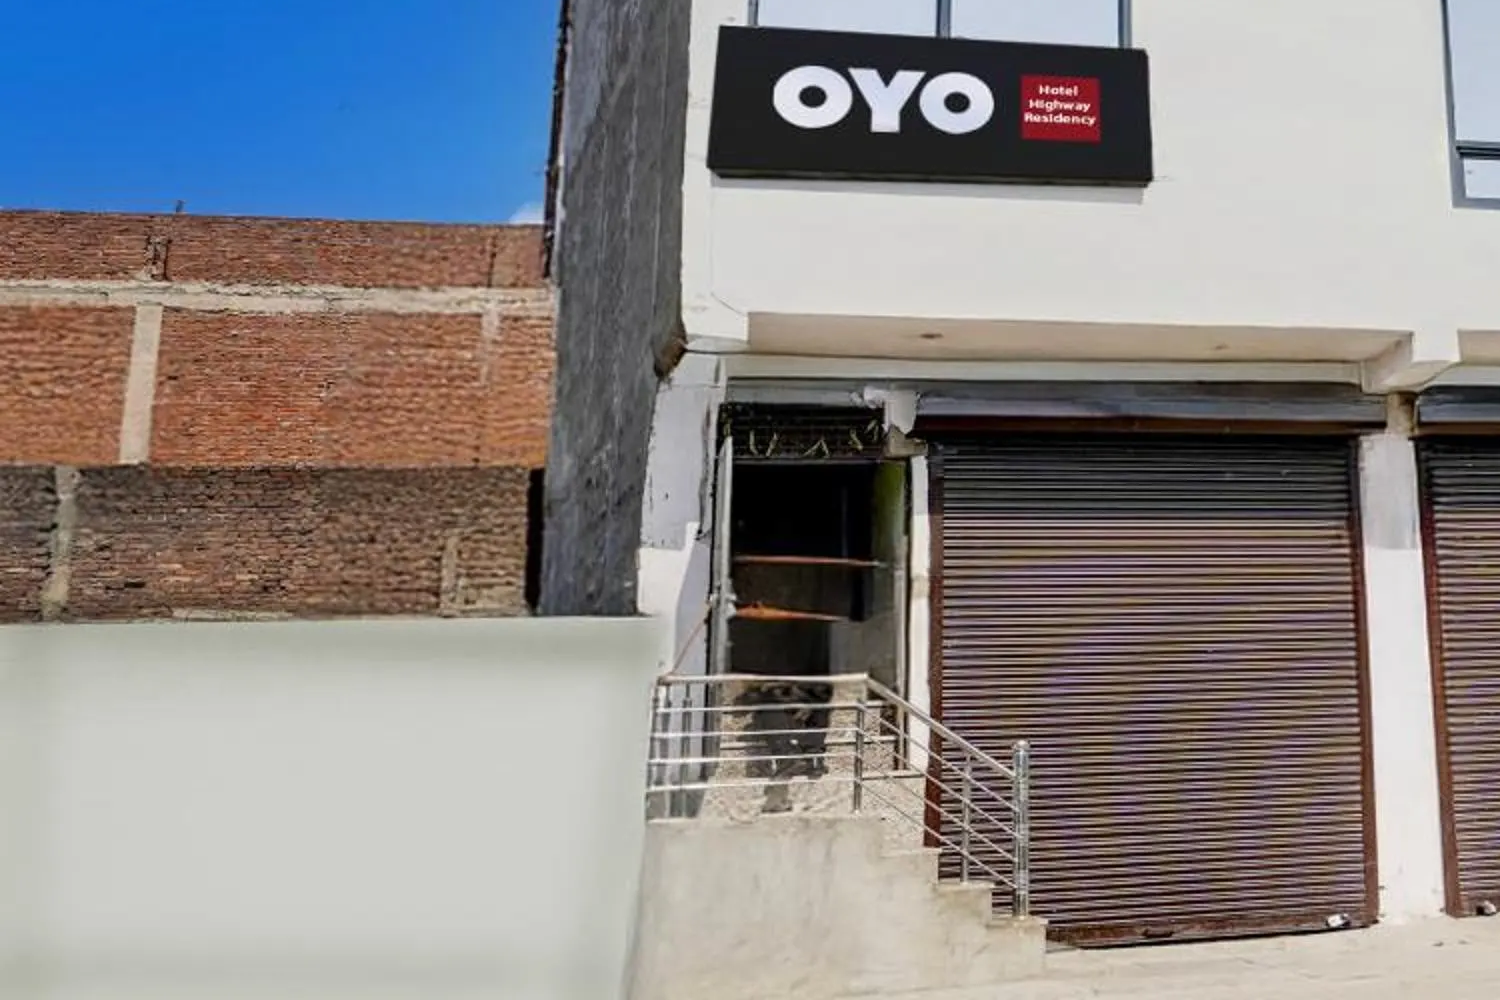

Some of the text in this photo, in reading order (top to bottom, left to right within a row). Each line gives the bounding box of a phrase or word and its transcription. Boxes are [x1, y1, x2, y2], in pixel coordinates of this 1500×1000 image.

[1038, 84, 1078, 97] Hotel
[773, 65, 994, 134] OYO
[1029, 99, 1091, 112] Highway
[1023, 112, 1096, 126] Residency
